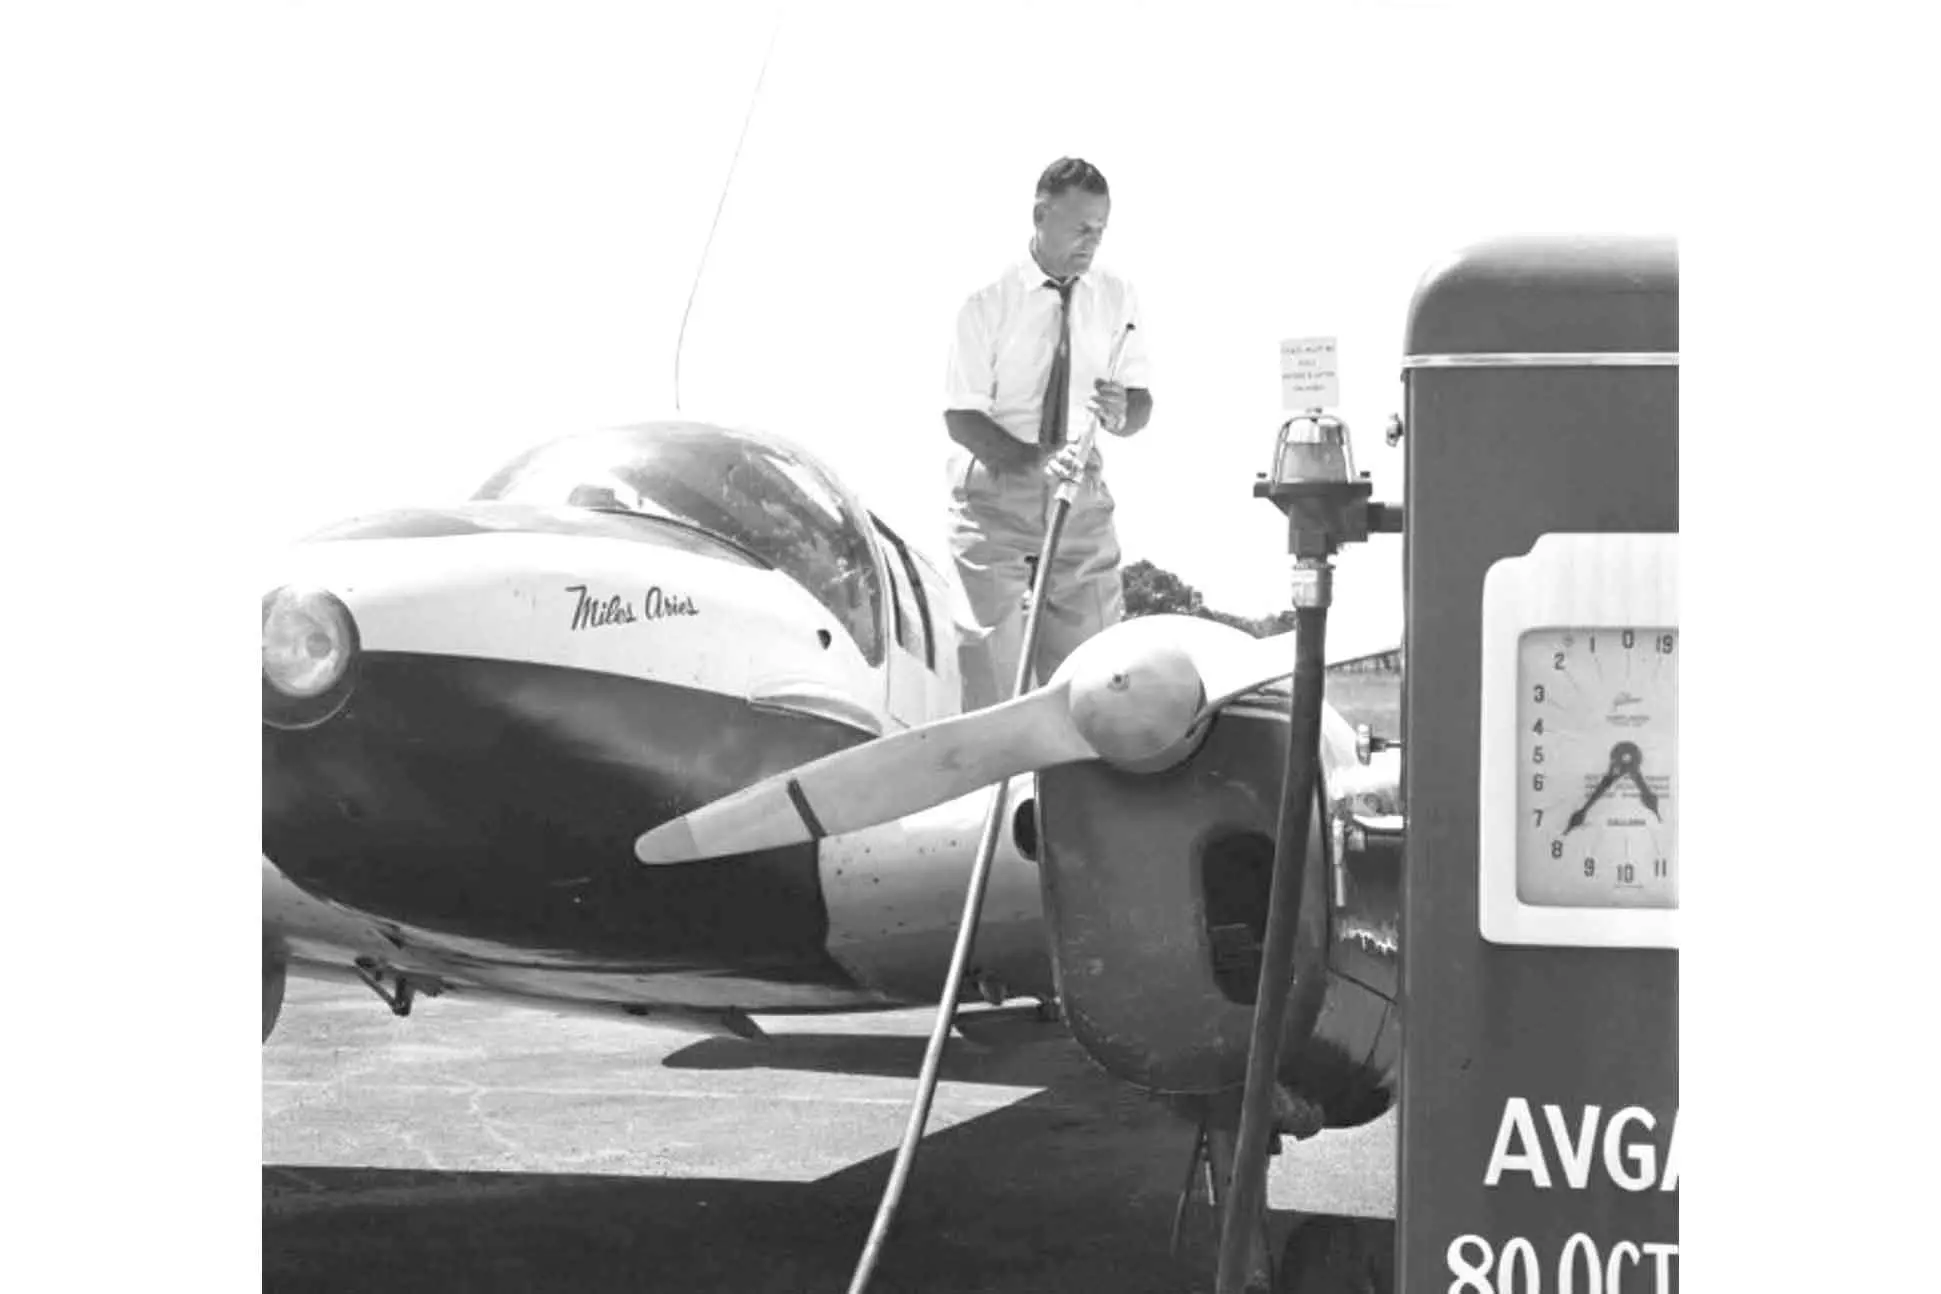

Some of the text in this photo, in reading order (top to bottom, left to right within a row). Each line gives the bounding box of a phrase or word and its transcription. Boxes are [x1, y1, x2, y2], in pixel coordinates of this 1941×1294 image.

[565, 584, 699, 630] Miles Aries
[1589, 636, 1596, 653] 1
[1621, 629, 1635, 649] 0
[1656, 634, 1673, 654] 19
[1553, 653, 1565, 670] 2
[1533, 684, 1545, 703] 3
[1532, 718, 1544, 736] 4
[1532, 746, 1544, 763] 5
[1533, 773, 1544, 792] 6
[1533, 809, 1544, 828] 7
[1551, 840, 1563, 859] 8
[1584, 857, 1596, 877] 9
[1616, 864, 1634, 883] 10
[1654, 859, 1667, 877] 11
[1483, 1097, 1679, 1192] AVG
[1446, 1234, 1541, 1294] 80
